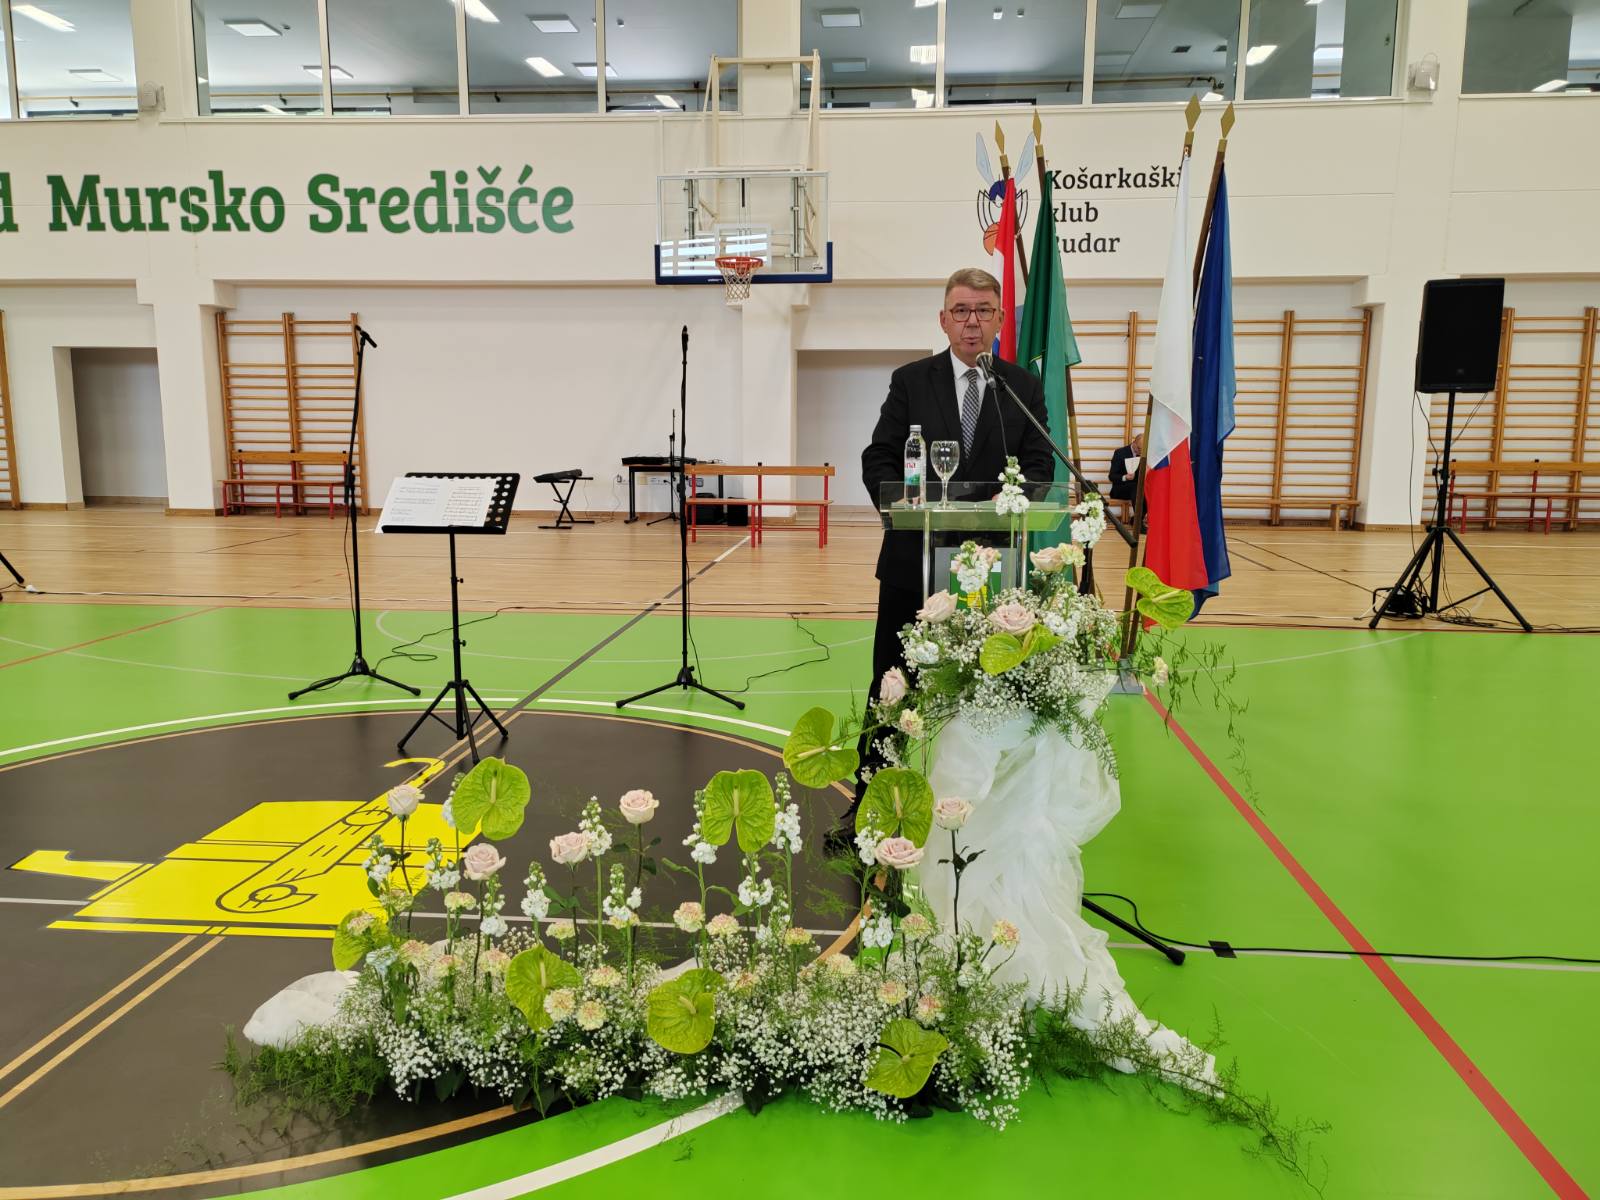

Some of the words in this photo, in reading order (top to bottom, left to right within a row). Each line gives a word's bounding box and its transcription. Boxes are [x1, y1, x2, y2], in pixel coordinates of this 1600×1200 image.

[46, 170, 285, 233] Mursko
[308, 164, 575, 234] Središće
[1056, 232, 1121, 254] udar
